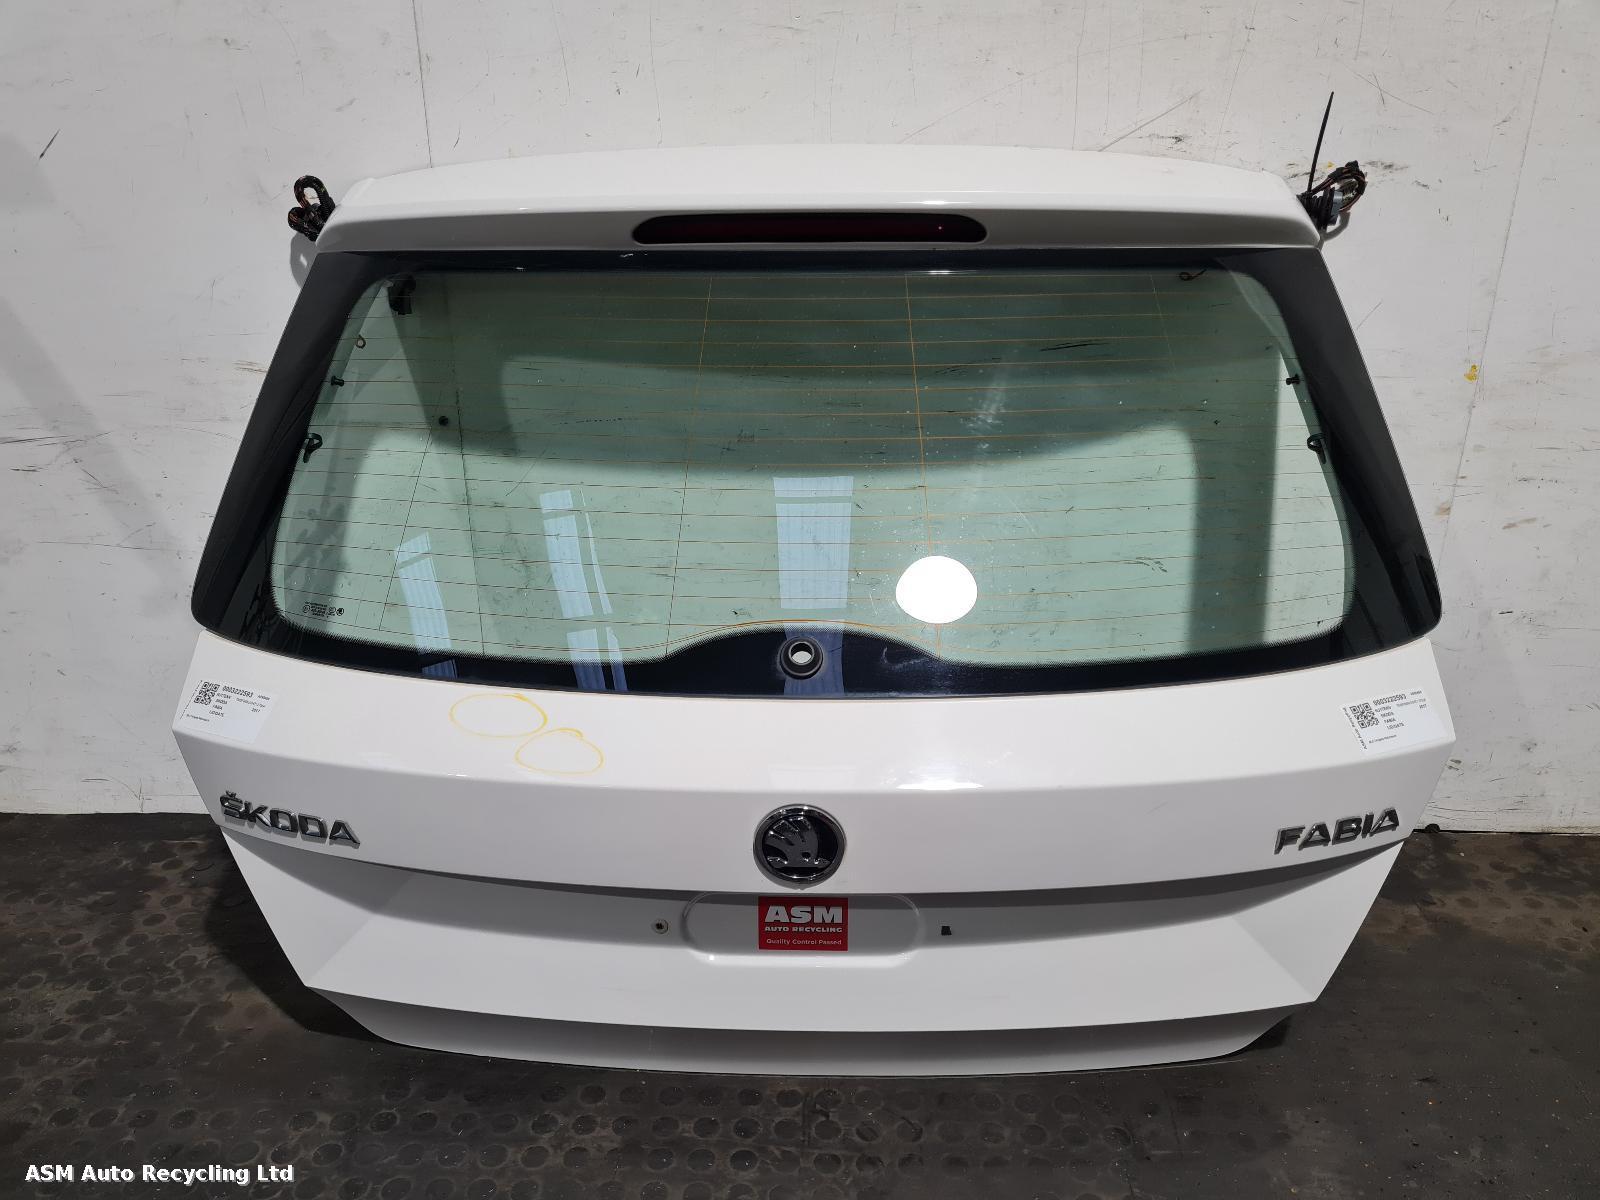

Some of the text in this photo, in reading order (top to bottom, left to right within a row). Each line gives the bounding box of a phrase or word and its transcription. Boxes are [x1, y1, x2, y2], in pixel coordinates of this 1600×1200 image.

[219, 789, 361, 848] ŠKODA
[1274, 807, 1399, 855] FABIA
[764, 905, 843, 924] ASM
